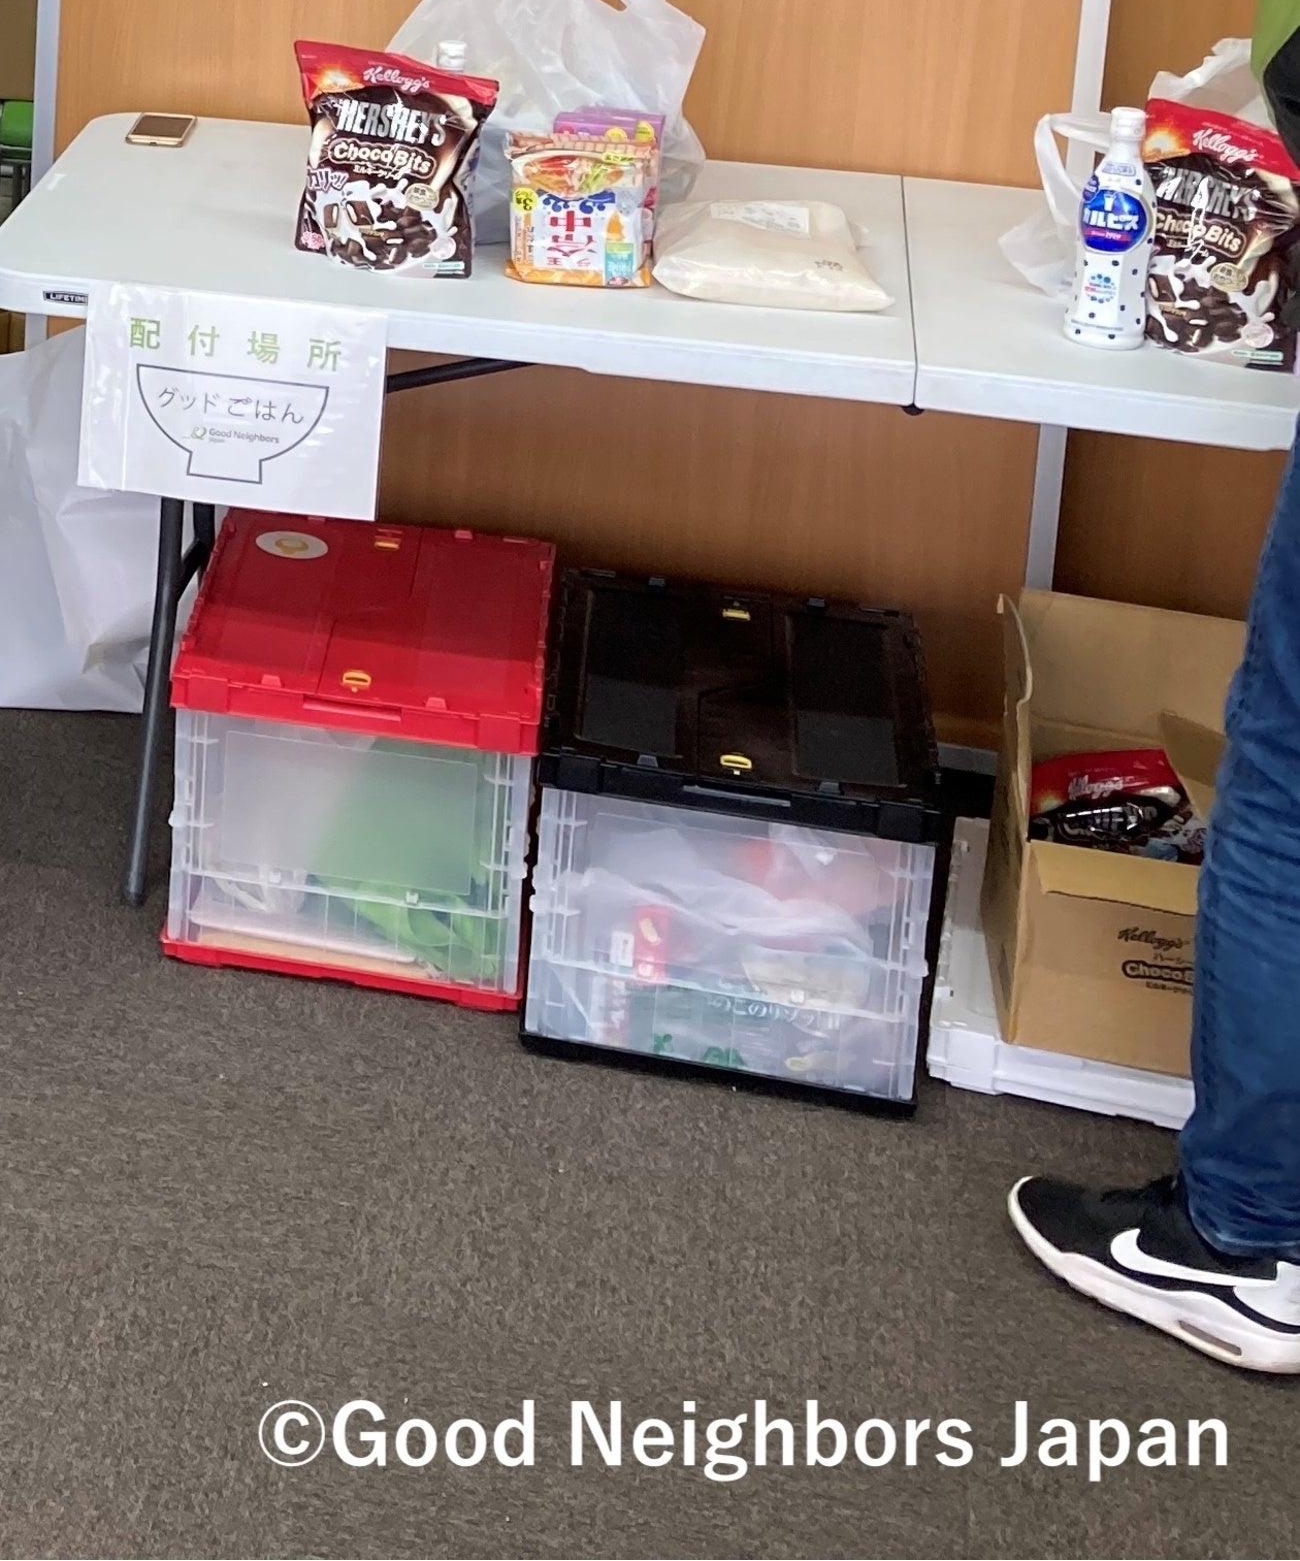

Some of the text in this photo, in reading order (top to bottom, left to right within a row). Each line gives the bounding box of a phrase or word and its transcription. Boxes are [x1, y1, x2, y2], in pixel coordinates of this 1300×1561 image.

[363, 66, 431, 93] Kellogg's
[337, 98, 448, 147] HERSHEY'S
[1192, 128, 1260, 164] Kellogg's
[129, 317, 343, 373] 配付場所
[157, 386, 305, 425] グッドごはん
[208, 426, 232, 439] Good
[1116, 926, 1184, 952] Kellogg's
